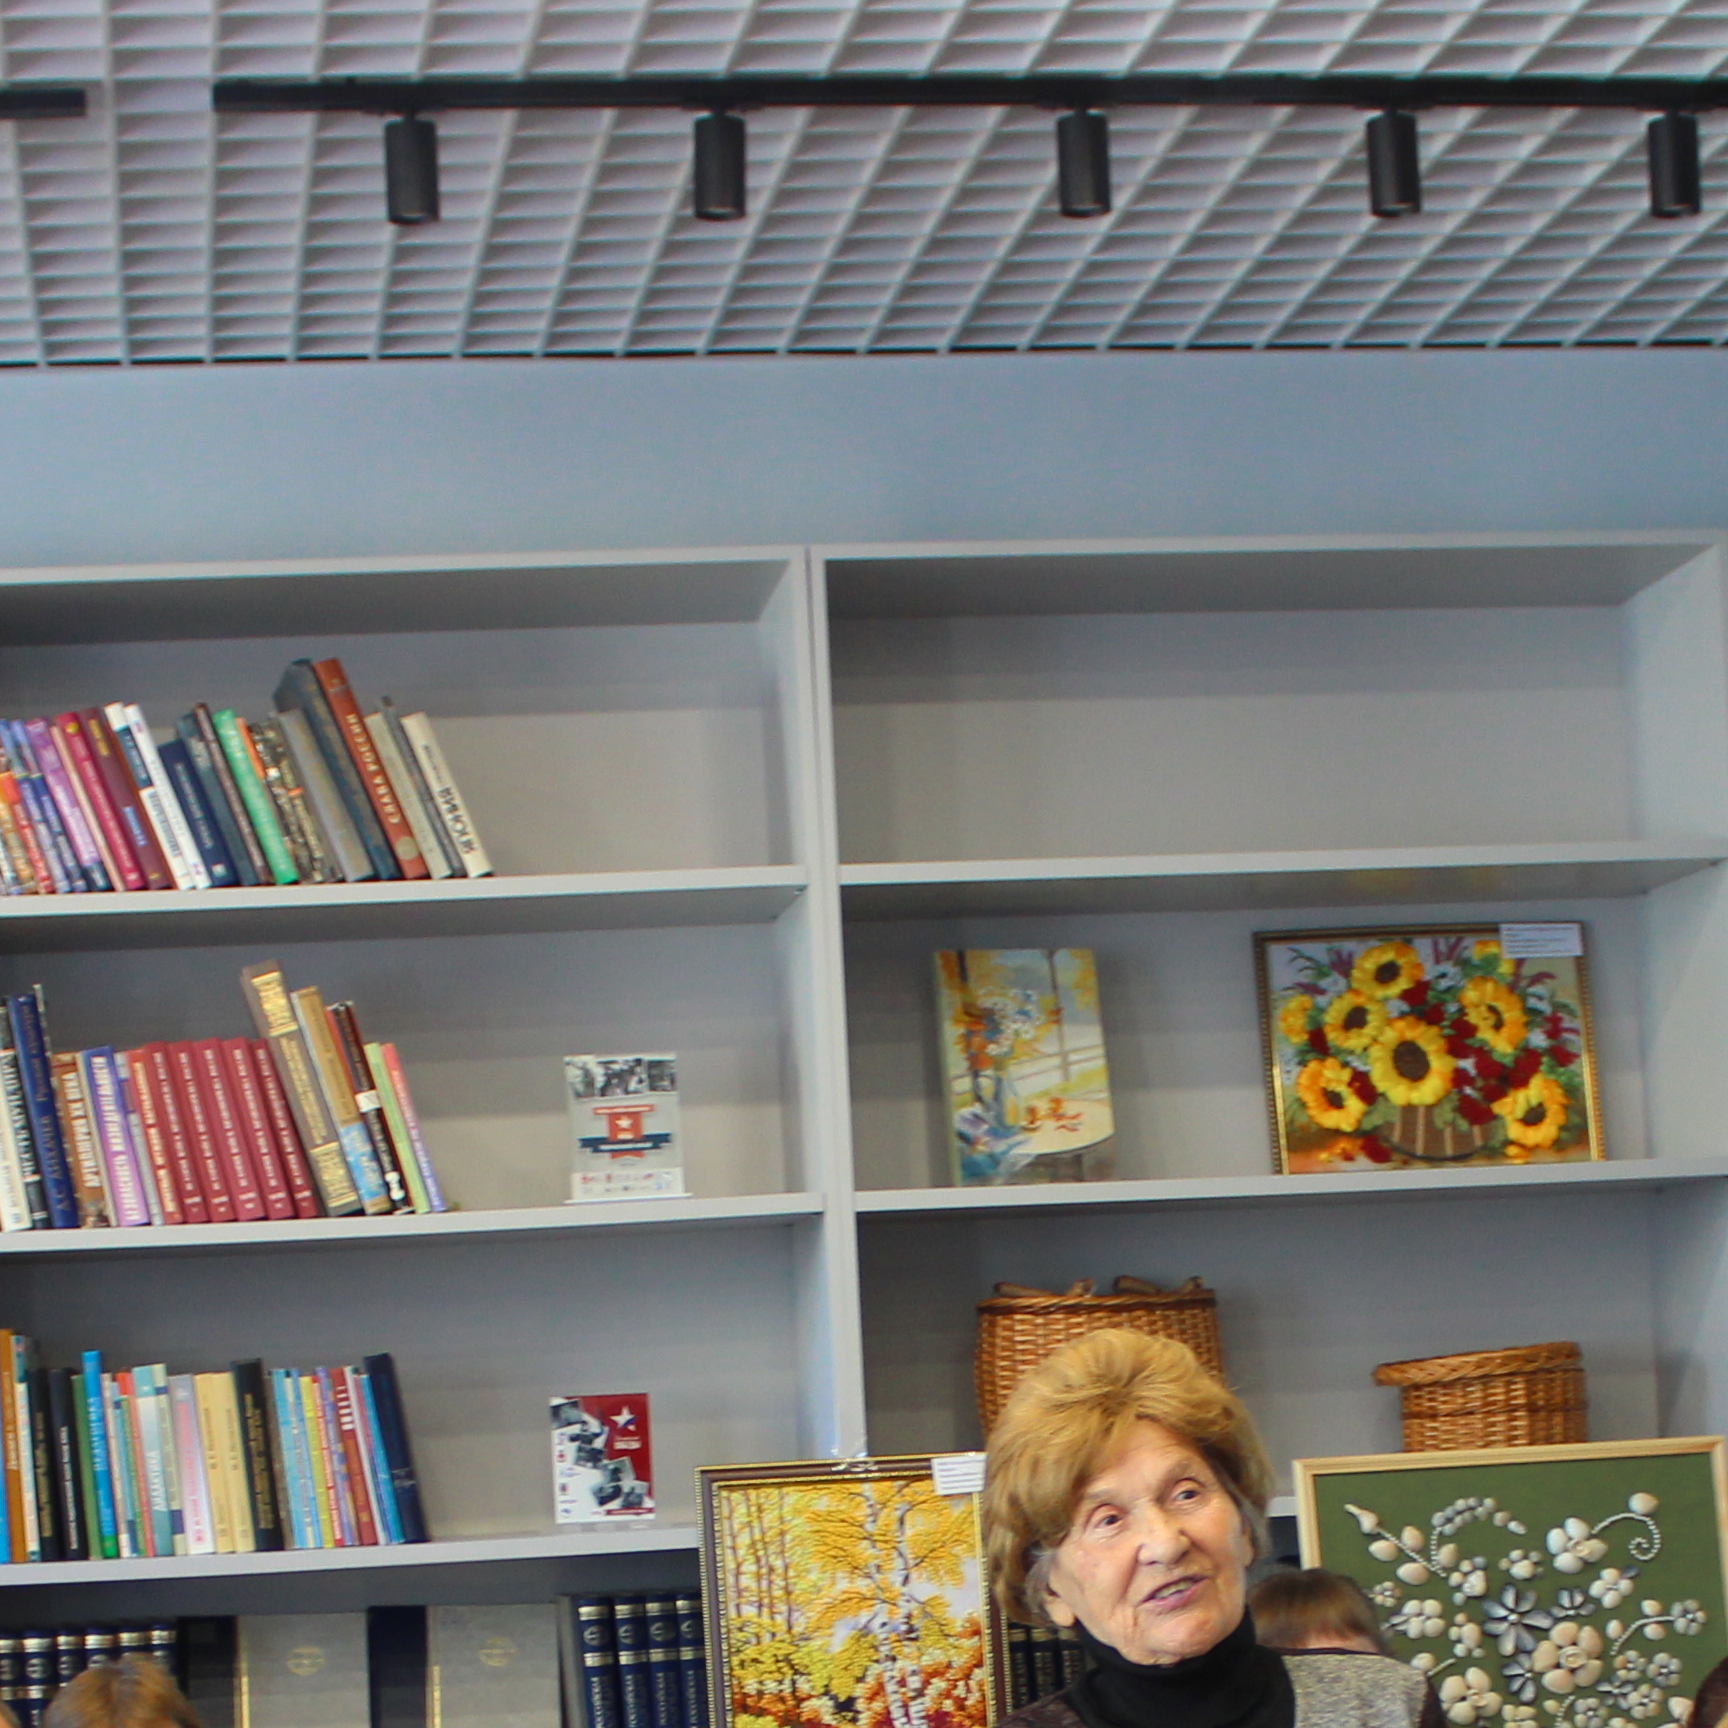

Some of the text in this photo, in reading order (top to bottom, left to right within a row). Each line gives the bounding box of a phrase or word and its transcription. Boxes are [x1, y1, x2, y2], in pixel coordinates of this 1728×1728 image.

[345, 713, 402, 825] СЛАВА РОССИИ
[436, 786, 477, 855] ЯПОНИЯ
[70, 1117, 101, 1189] АРТИЛЛЕРИЯ
